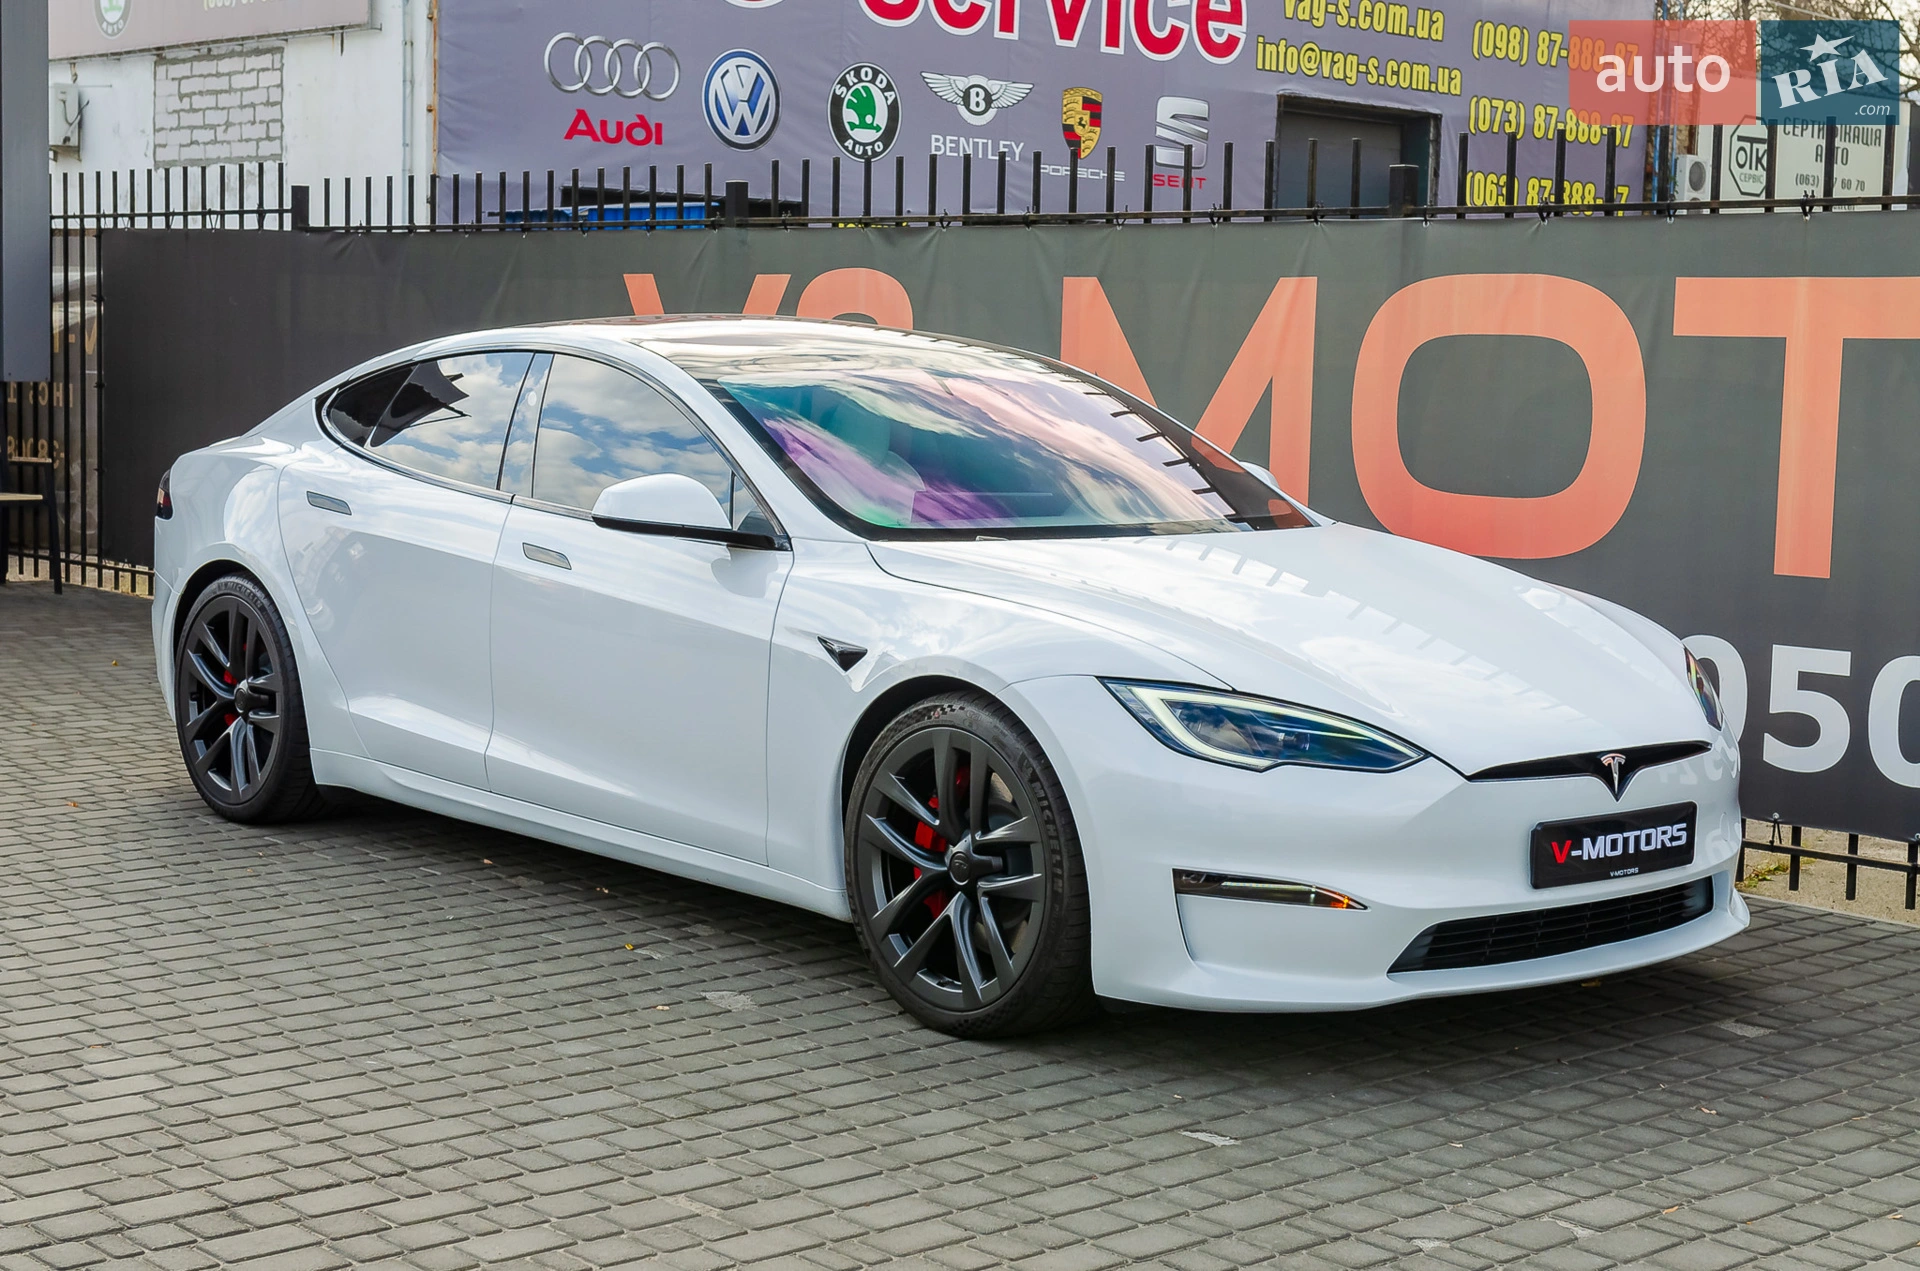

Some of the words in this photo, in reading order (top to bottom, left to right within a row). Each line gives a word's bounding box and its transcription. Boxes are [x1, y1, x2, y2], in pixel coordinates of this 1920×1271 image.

[1256, 35, 1463, 96] info@vag-s.com.ua
[1472, 19, 1530, 67] (098)
[1535, 30, 1639, 77] 87-888-87
[563, 108, 664, 146] Audi
[1468, 95, 1526, 139] (073)
[1532, 104, 1635, 148] 87-888-87
[844, 138, 884, 156] AUTO
[931, 134, 1025, 161] BENTLEY
[1815, 144, 1849, 166] АТО
[1465, 171, 1519, 207] (063)
[1526, 176, 1630, 217] 87-888-7
[1795, 173, 1820, 188] (063)
[1841, 178, 1852, 190] 60
[1855, 179, 1866, 192] 70
[1031, 782, 1063, 894] MICHELIN
[1551, 823, 1688, 864] V-MOTORS
[1610, 867, 1639, 877] V-MOTORS
